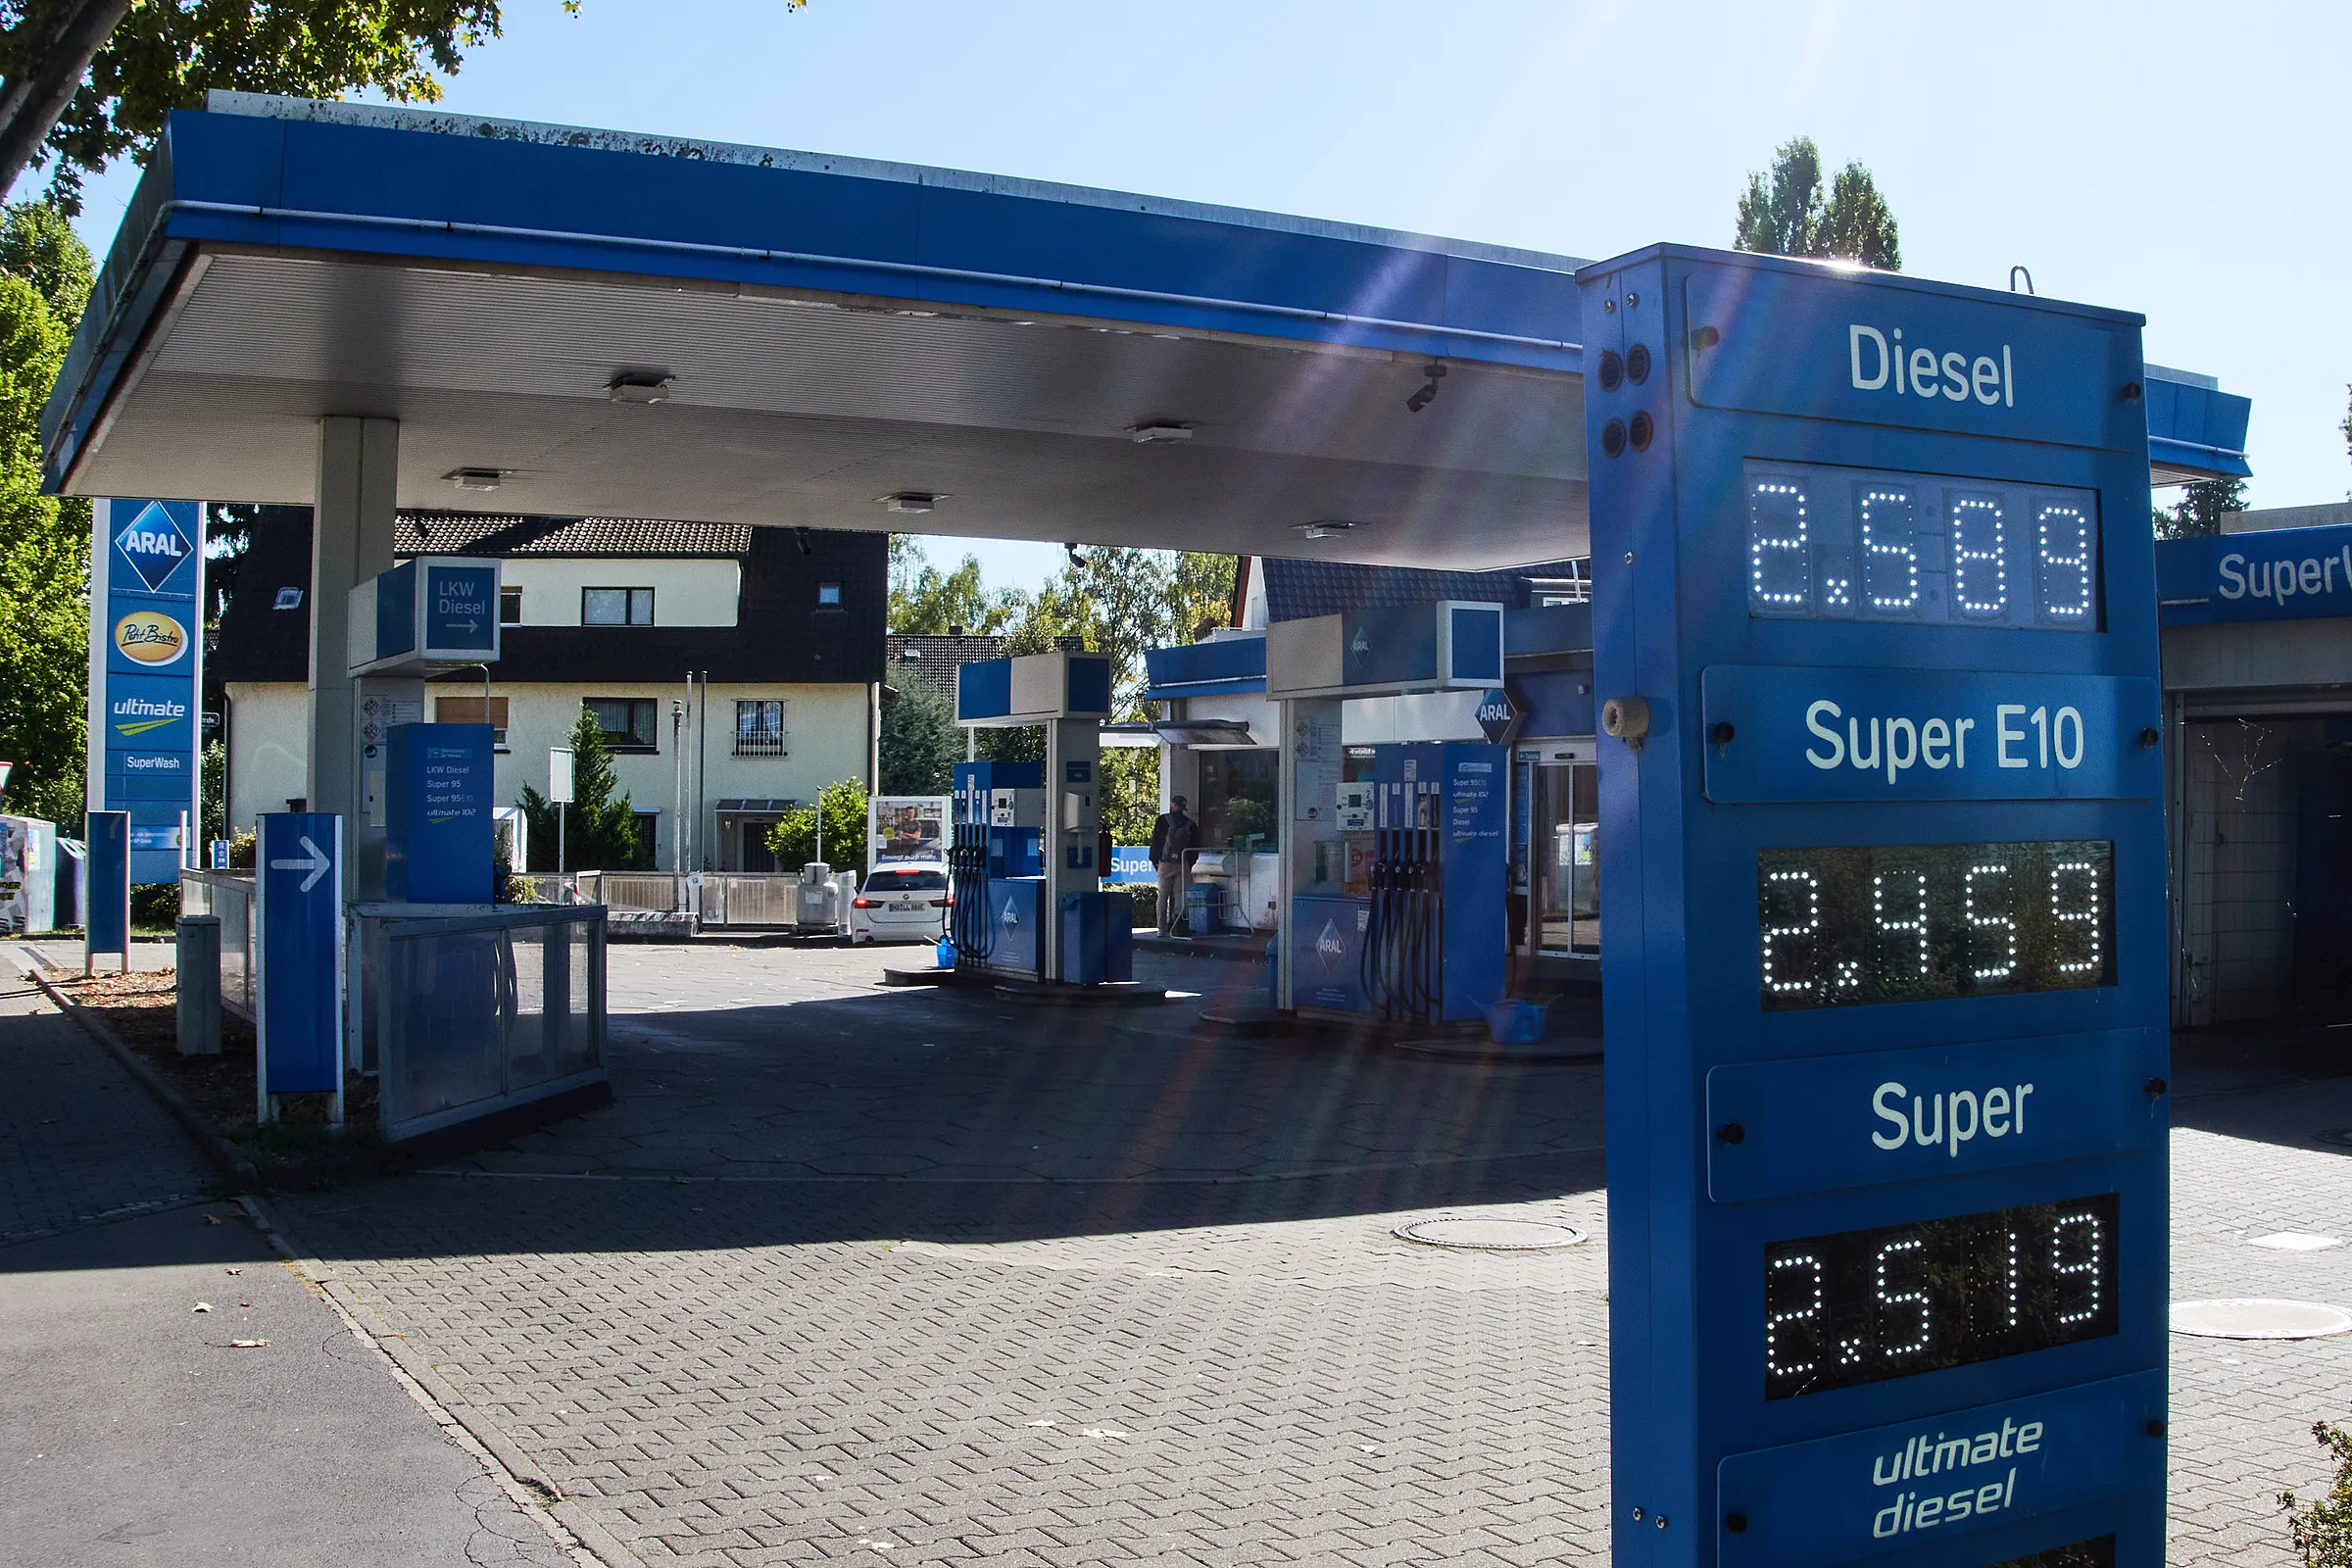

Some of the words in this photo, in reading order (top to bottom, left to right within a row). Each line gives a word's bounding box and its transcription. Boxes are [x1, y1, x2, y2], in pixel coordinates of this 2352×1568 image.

[1849, 323, 2014, 408] Diesel
[124, 530, 182, 558] ARAL
[2219, 544, 2352, 607] Super
[439, 580, 474, 597] LKW
[439, 599, 486, 615] Diesel
[123, 623, 146, 643] Petit
[144, 624, 179, 643] Bistro
[1349, 640, 1369, 652] ARAL
[114, 698, 185, 716] ultimate
[1480, 703, 1511, 721] ARAL
[1805, 699, 1976, 785] Super
[1995, 703, 2085, 770] E10
[126, 756, 180, 770] SuperWash
[426, 765, 444, 774] LKW
[446, 765, 469, 774] Diesel
[426, 780, 450, 789] Super
[1452, 778, 1469, 787] Super
[426, 794, 450, 804] Super
[1111, 857, 1154, 876] Super
[1003, 911, 1018, 924] ARAL
[1319, 939, 1343, 954] ARAL
[1871, 1081, 2034, 1158] Super
[1873, 1416, 2044, 1487] ultimate
[1873, 1468, 2017, 1540] diesel
